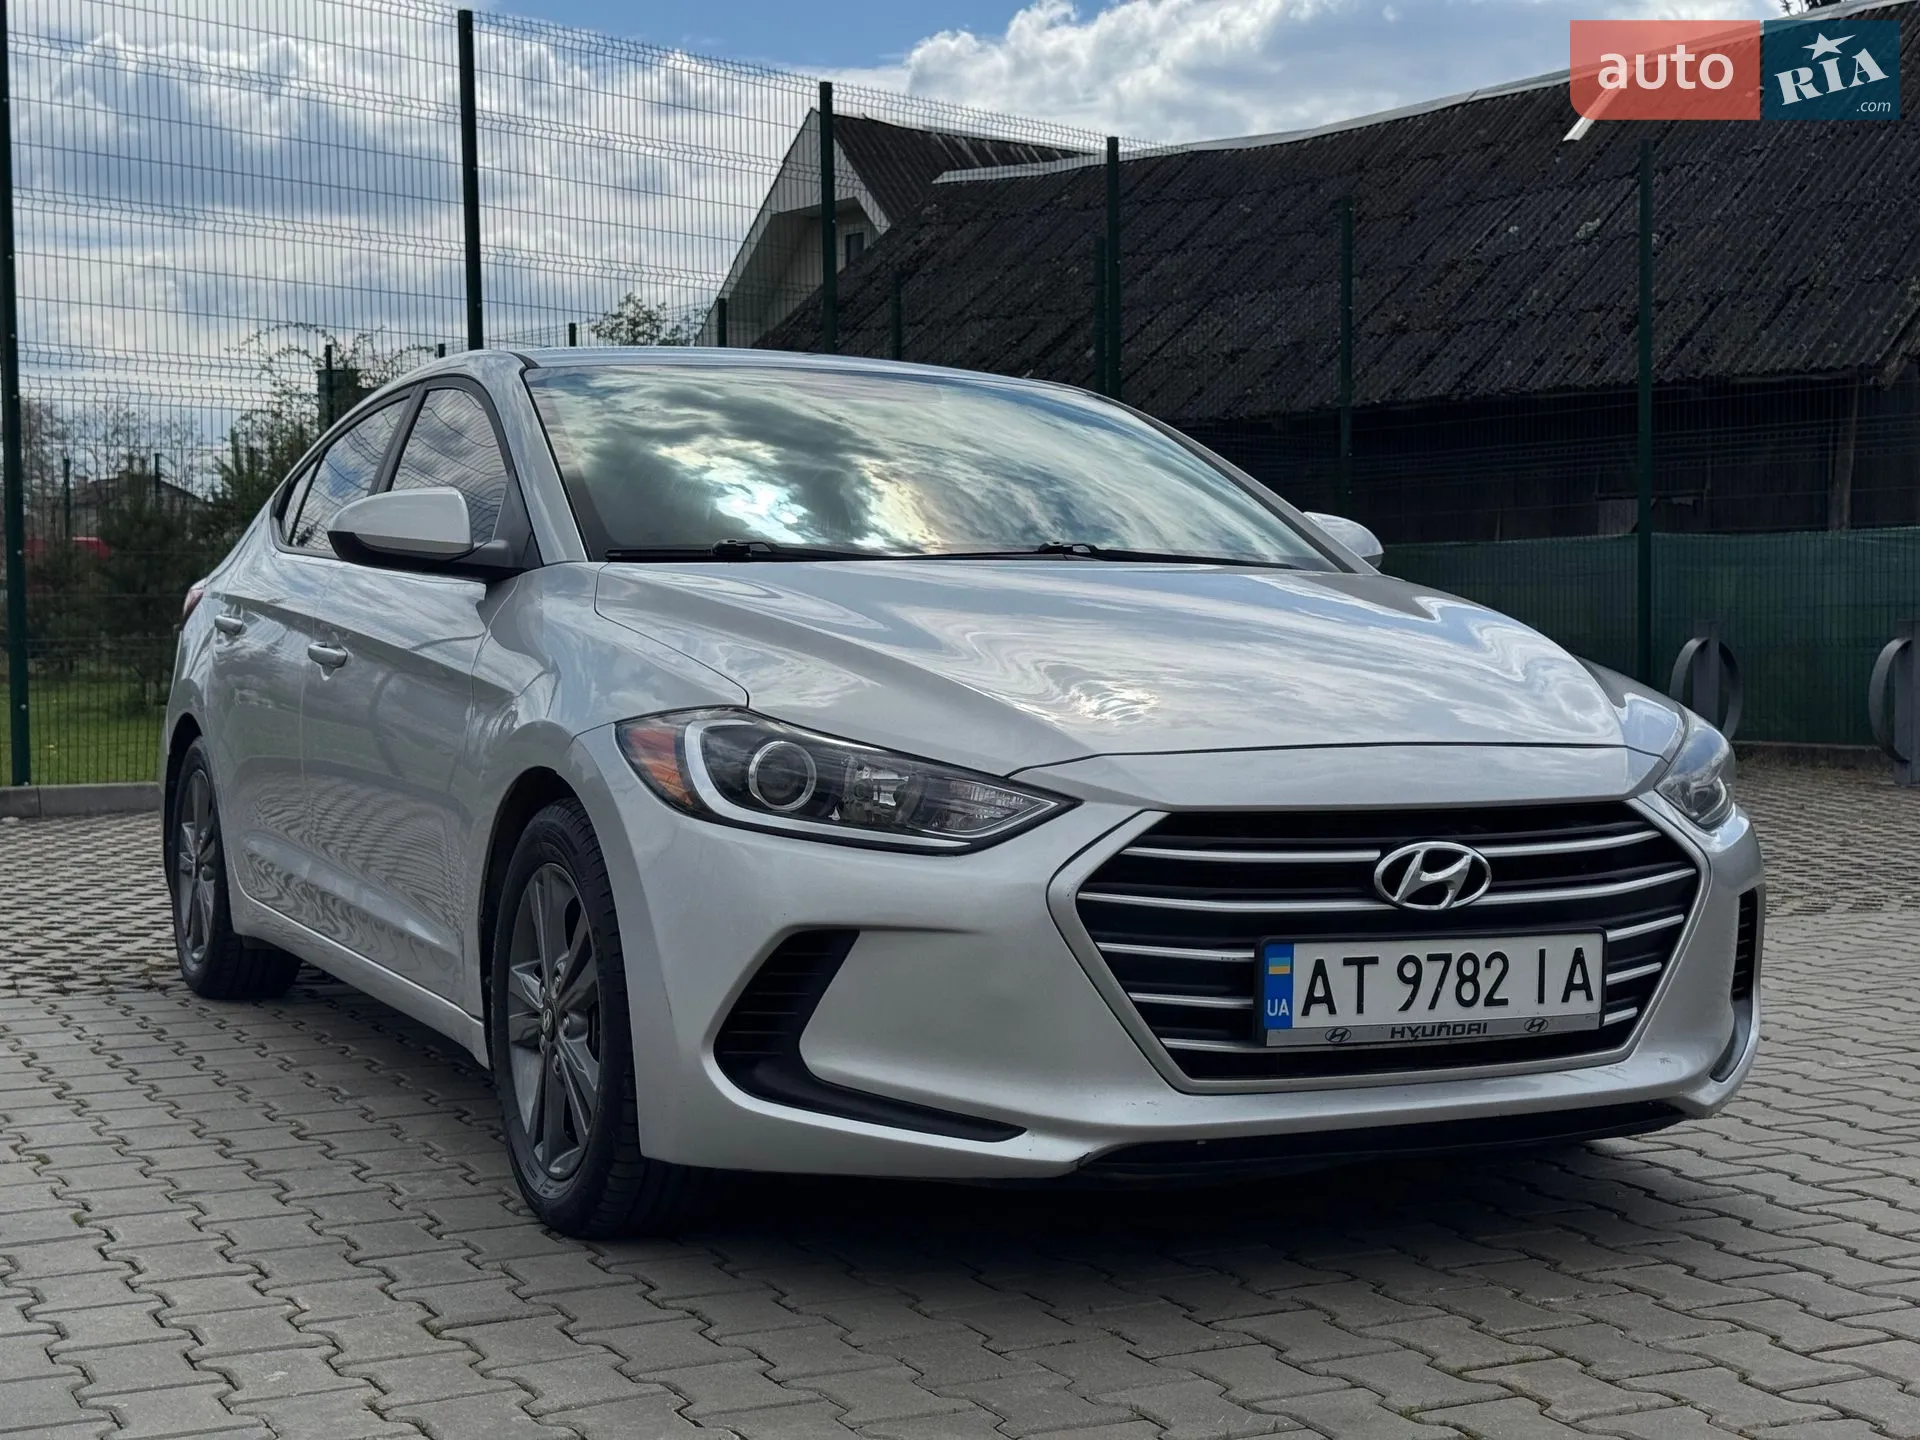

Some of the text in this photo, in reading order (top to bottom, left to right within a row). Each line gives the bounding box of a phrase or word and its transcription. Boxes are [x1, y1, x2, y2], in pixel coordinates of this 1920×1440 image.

[1301, 947, 1594, 1017] AT 9782 IA
[1267, 999, 1290, 1017] UA
[1390, 1022, 1488, 1040] HYUNDAI
